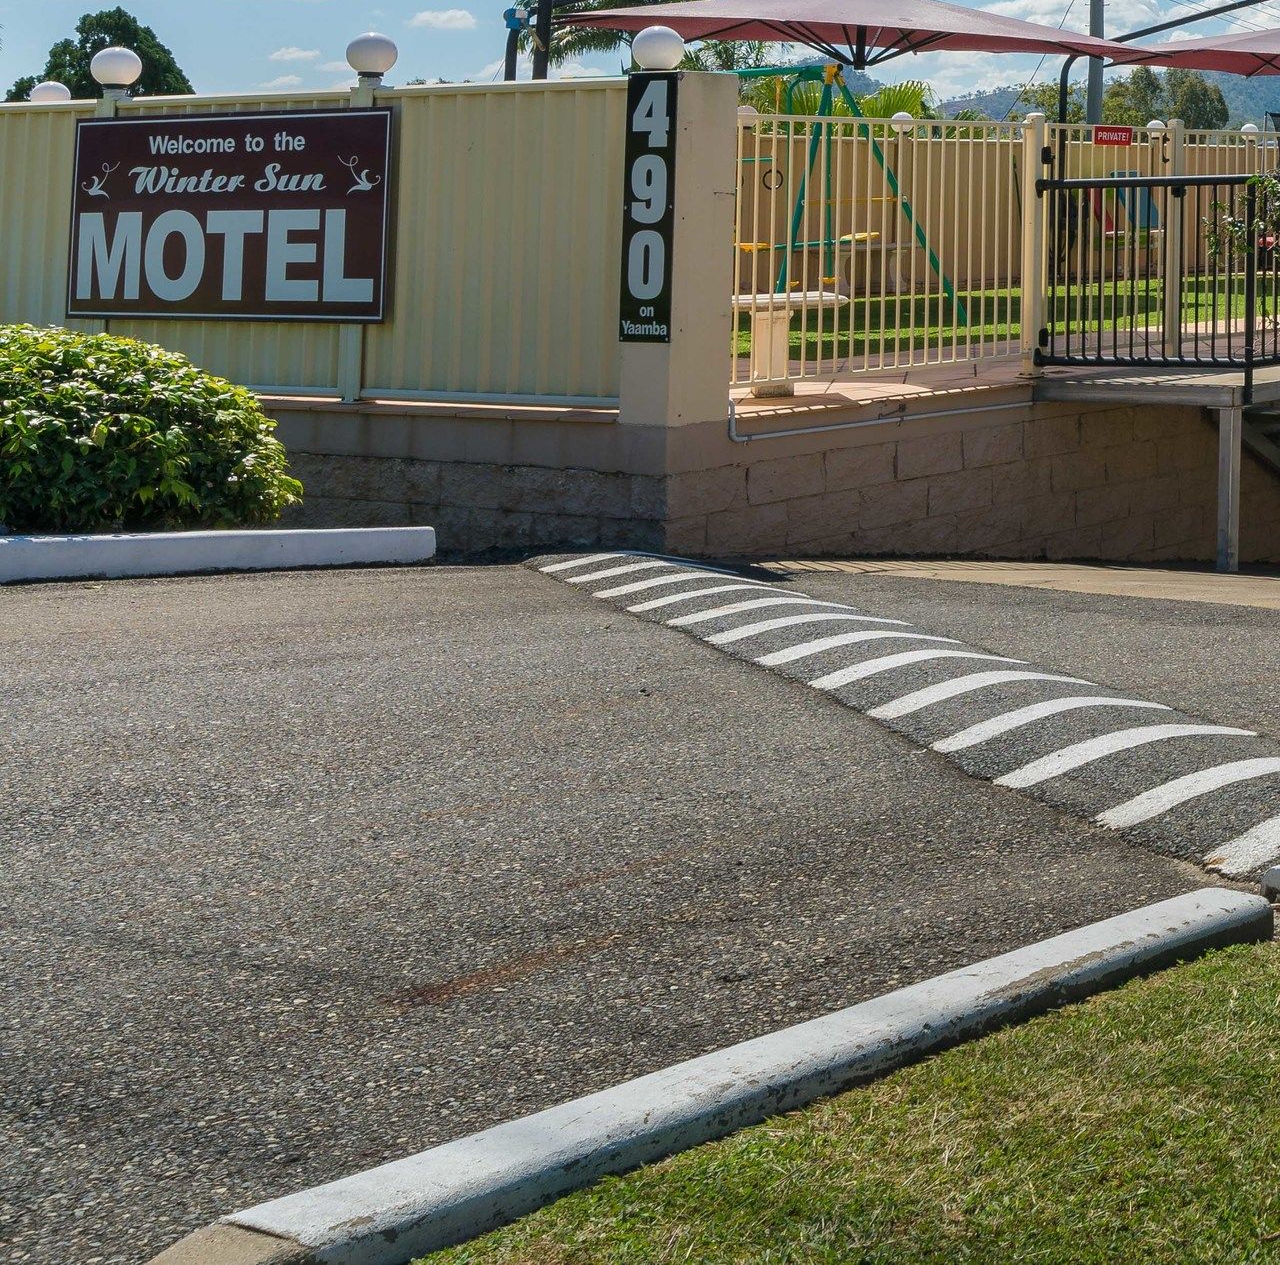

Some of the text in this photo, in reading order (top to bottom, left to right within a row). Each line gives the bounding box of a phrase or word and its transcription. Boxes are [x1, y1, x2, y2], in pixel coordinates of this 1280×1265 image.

[149, 131, 306, 155] Welcome to the
[1097, 131, 1130, 142] PRIVATE!
[128, 162, 327, 195] Winter Sun
[627, 79, 670, 301] 490
[76, 209, 375, 303] MOTEL
[639, 305, 655, 318] on
[621, 320, 668, 336] Yaamba
